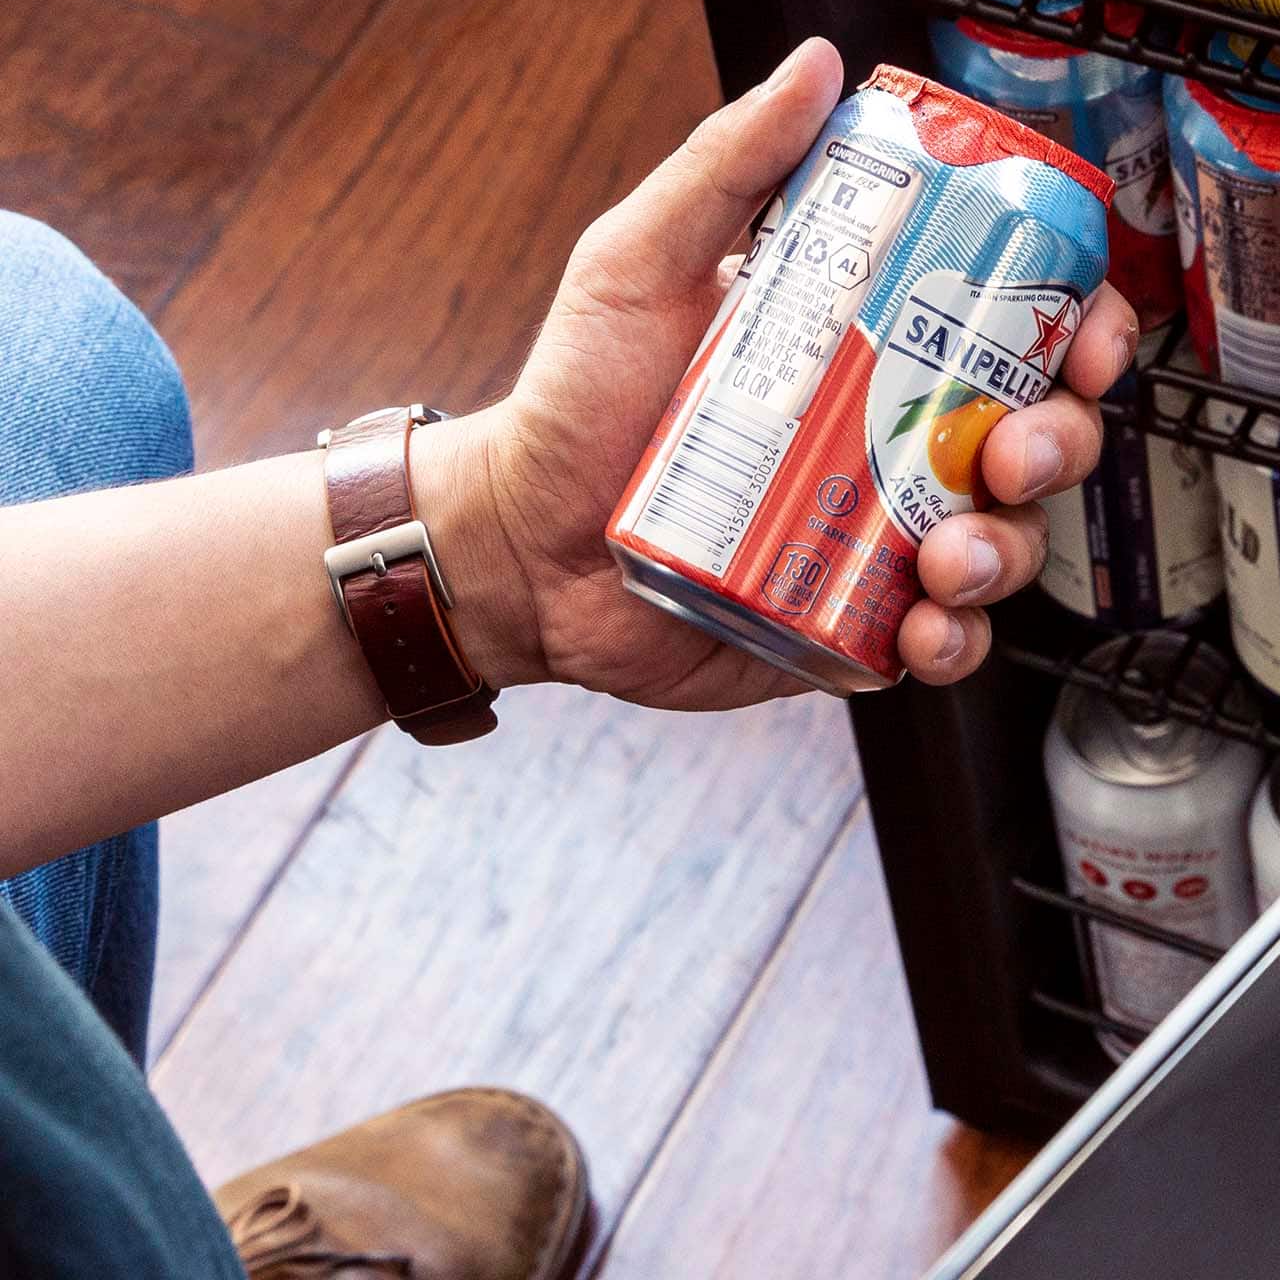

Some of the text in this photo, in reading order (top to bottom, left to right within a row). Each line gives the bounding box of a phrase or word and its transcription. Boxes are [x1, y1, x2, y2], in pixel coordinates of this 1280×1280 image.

[828, 144, 906, 185] SANPELLEGRINO
[837, 258, 857, 276] AL
[999, 294, 1037, 303] SPARKLING
[1037, 294, 1061, 304] ORANGE
[733, 365, 776, 400] CA CRV
[776, 362, 799, 385] REF.
[724, 497, 755, 544] 41508
[750, 446, 780, 493] 30034
[784, 551, 821, 587] 130
[876, 545, 916, 581] BLOO
